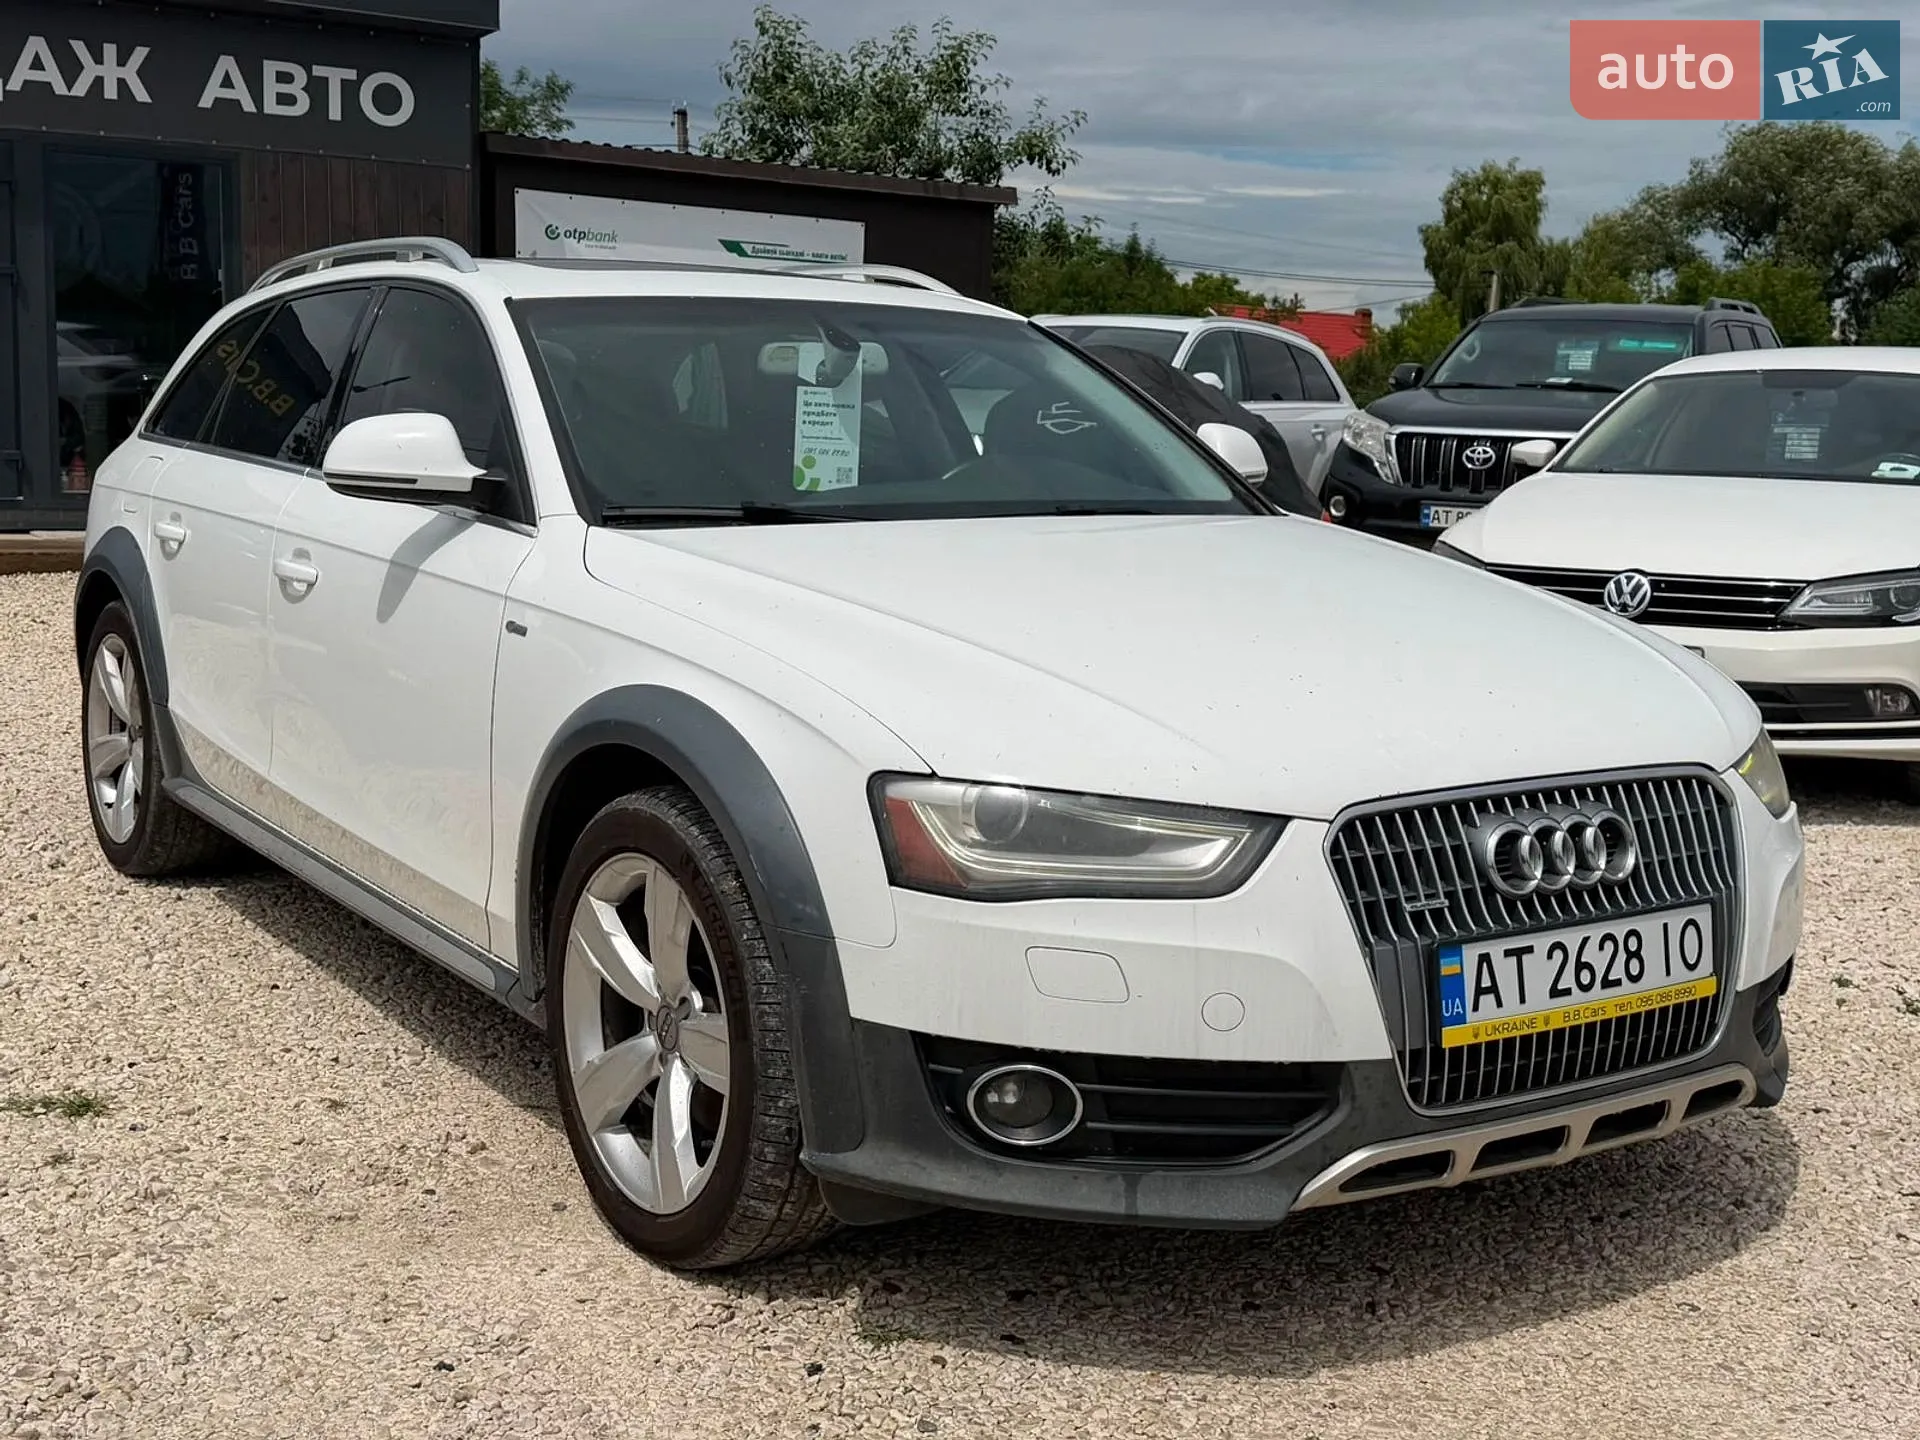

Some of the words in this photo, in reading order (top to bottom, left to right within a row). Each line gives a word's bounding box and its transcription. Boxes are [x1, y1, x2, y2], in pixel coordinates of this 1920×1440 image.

[0, 35, 152, 103] АЖ
[197, 55, 415, 127] АВТО
[563, 227, 618, 244] otpbank
[1431, 510, 1452, 524] AT
[1472, 944, 1535, 1012] AT
[1546, 928, 1645, 999] 2628
[1442, 998, 1464, 1017] UA
[1485, 1017, 1538, 1037] UKRAINE
[1636, 993, 1654, 1008] 095
[1655, 990, 1673, 1004] 086
